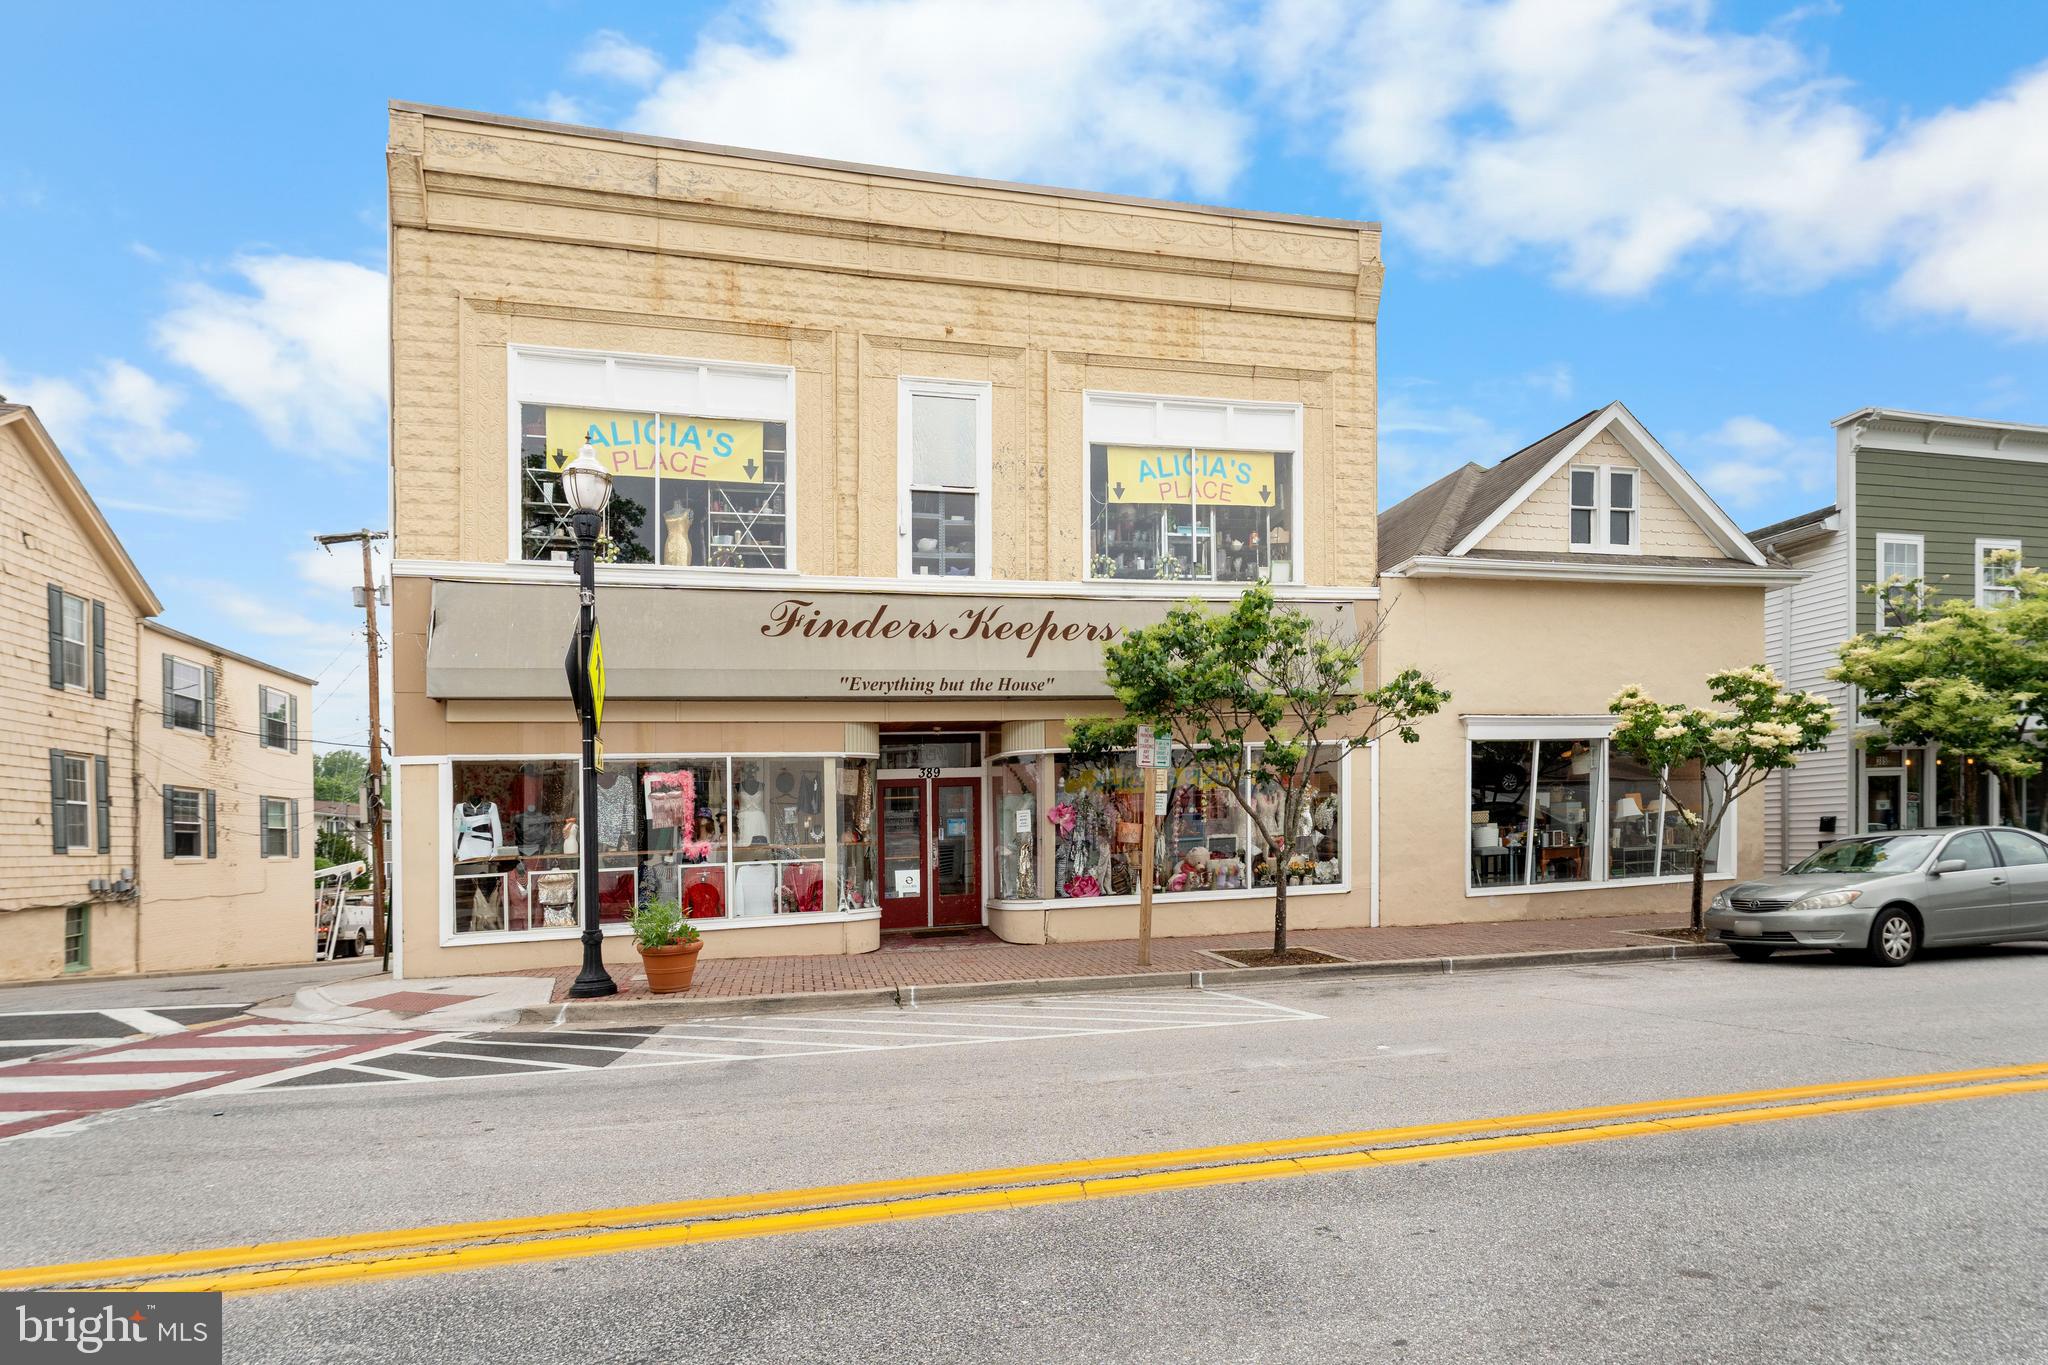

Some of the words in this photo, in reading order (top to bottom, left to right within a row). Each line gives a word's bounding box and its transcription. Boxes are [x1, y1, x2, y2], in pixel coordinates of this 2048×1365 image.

[589, 419, 735, 458] ALICIA'S
[612, 449, 710, 478] PLACE
[1139, 454, 1252, 484] ALICIA'S
[1159, 480, 1233, 502] PLACE
[761, 598, 948, 640] Finders
[950, 604, 1121, 659] Keepers
[840, 676, 934, 695] "Everything
[940, 677, 964, 692] but
[970, 677, 993, 692] the
[998, 677, 1055, 692] House"
[918, 767, 941, 779] 389
